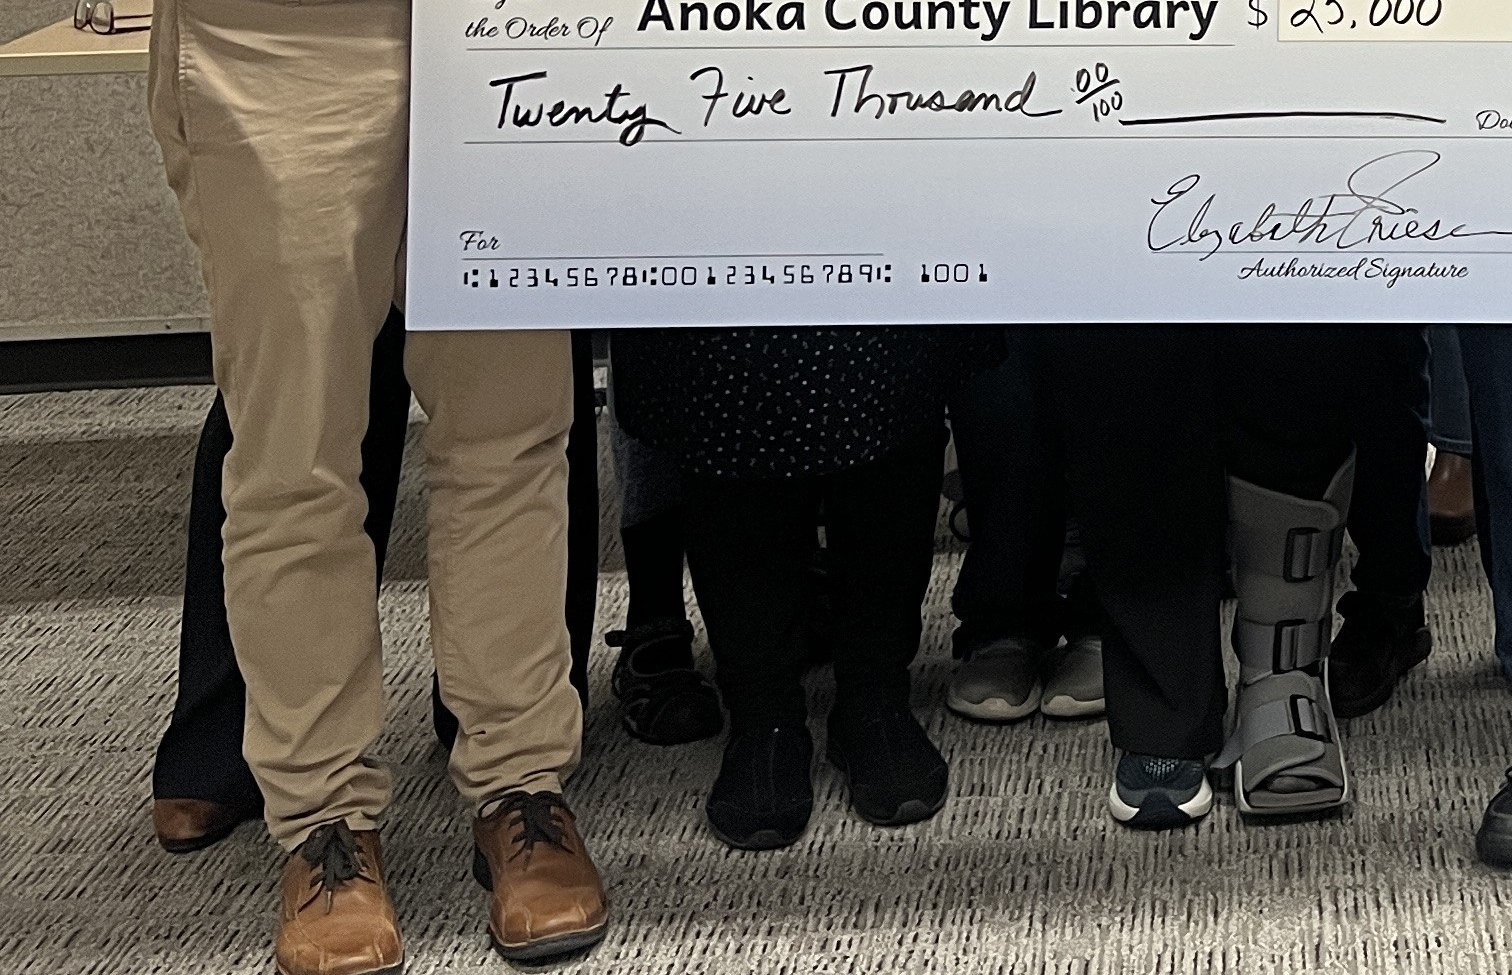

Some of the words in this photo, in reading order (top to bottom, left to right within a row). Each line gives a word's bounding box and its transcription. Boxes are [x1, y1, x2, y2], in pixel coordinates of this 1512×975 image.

[465, 17, 499, 38] the
[505, 17, 571, 39] Order
[576, 16, 614, 47] Of
[489, 71, 682, 146] Twenty
[690, 66, 792, 128] Five
[824, 64, 1063, 118] Thousand
[460, 231, 501, 251] For
[920, 263, 988, 283] 1001
[1237, 257, 1362, 281] Authorized
[1364, 257, 1469, 289] Signature
